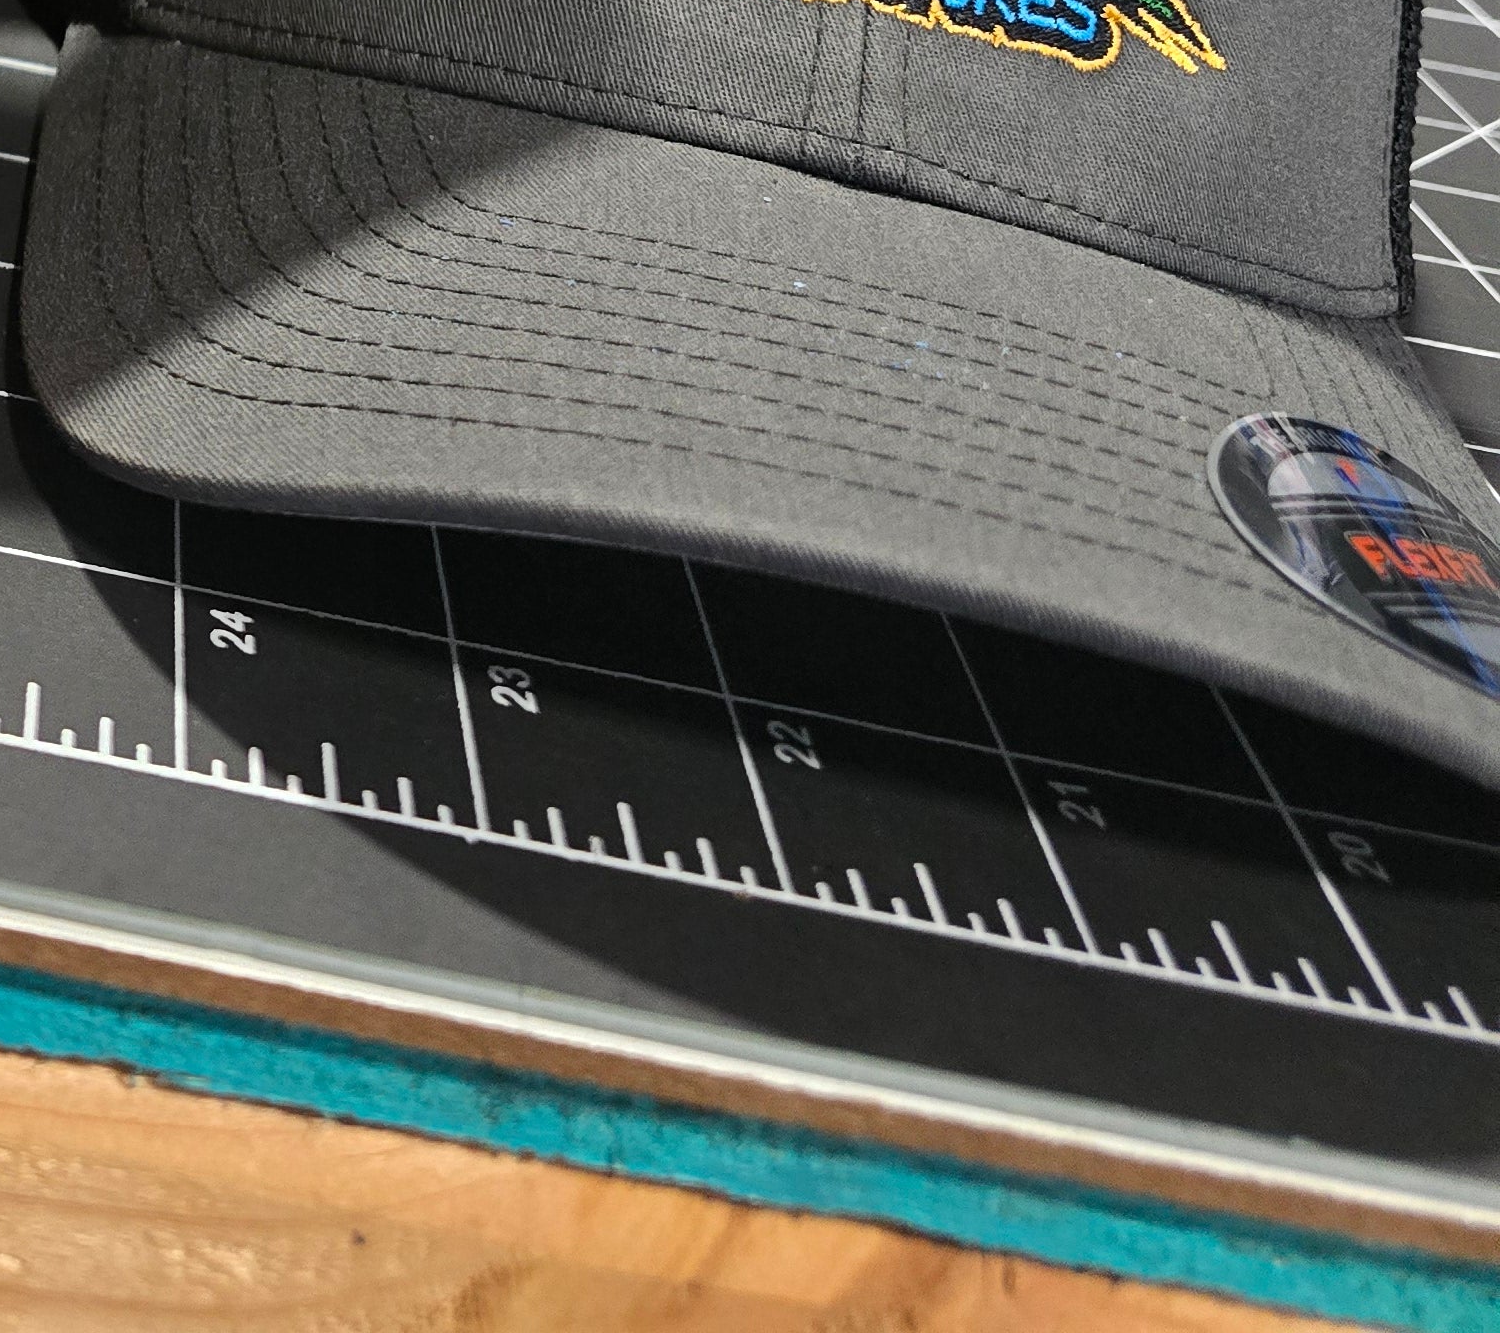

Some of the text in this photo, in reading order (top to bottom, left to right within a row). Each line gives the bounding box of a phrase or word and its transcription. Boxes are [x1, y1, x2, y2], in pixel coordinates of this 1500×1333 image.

[209, 607, 258, 656] 24
[485, 663, 542, 715] 23
[765, 718, 825, 770] 22
[1046, 777, 1107, 829] 21
[1326, 830, 1392, 884] 20
